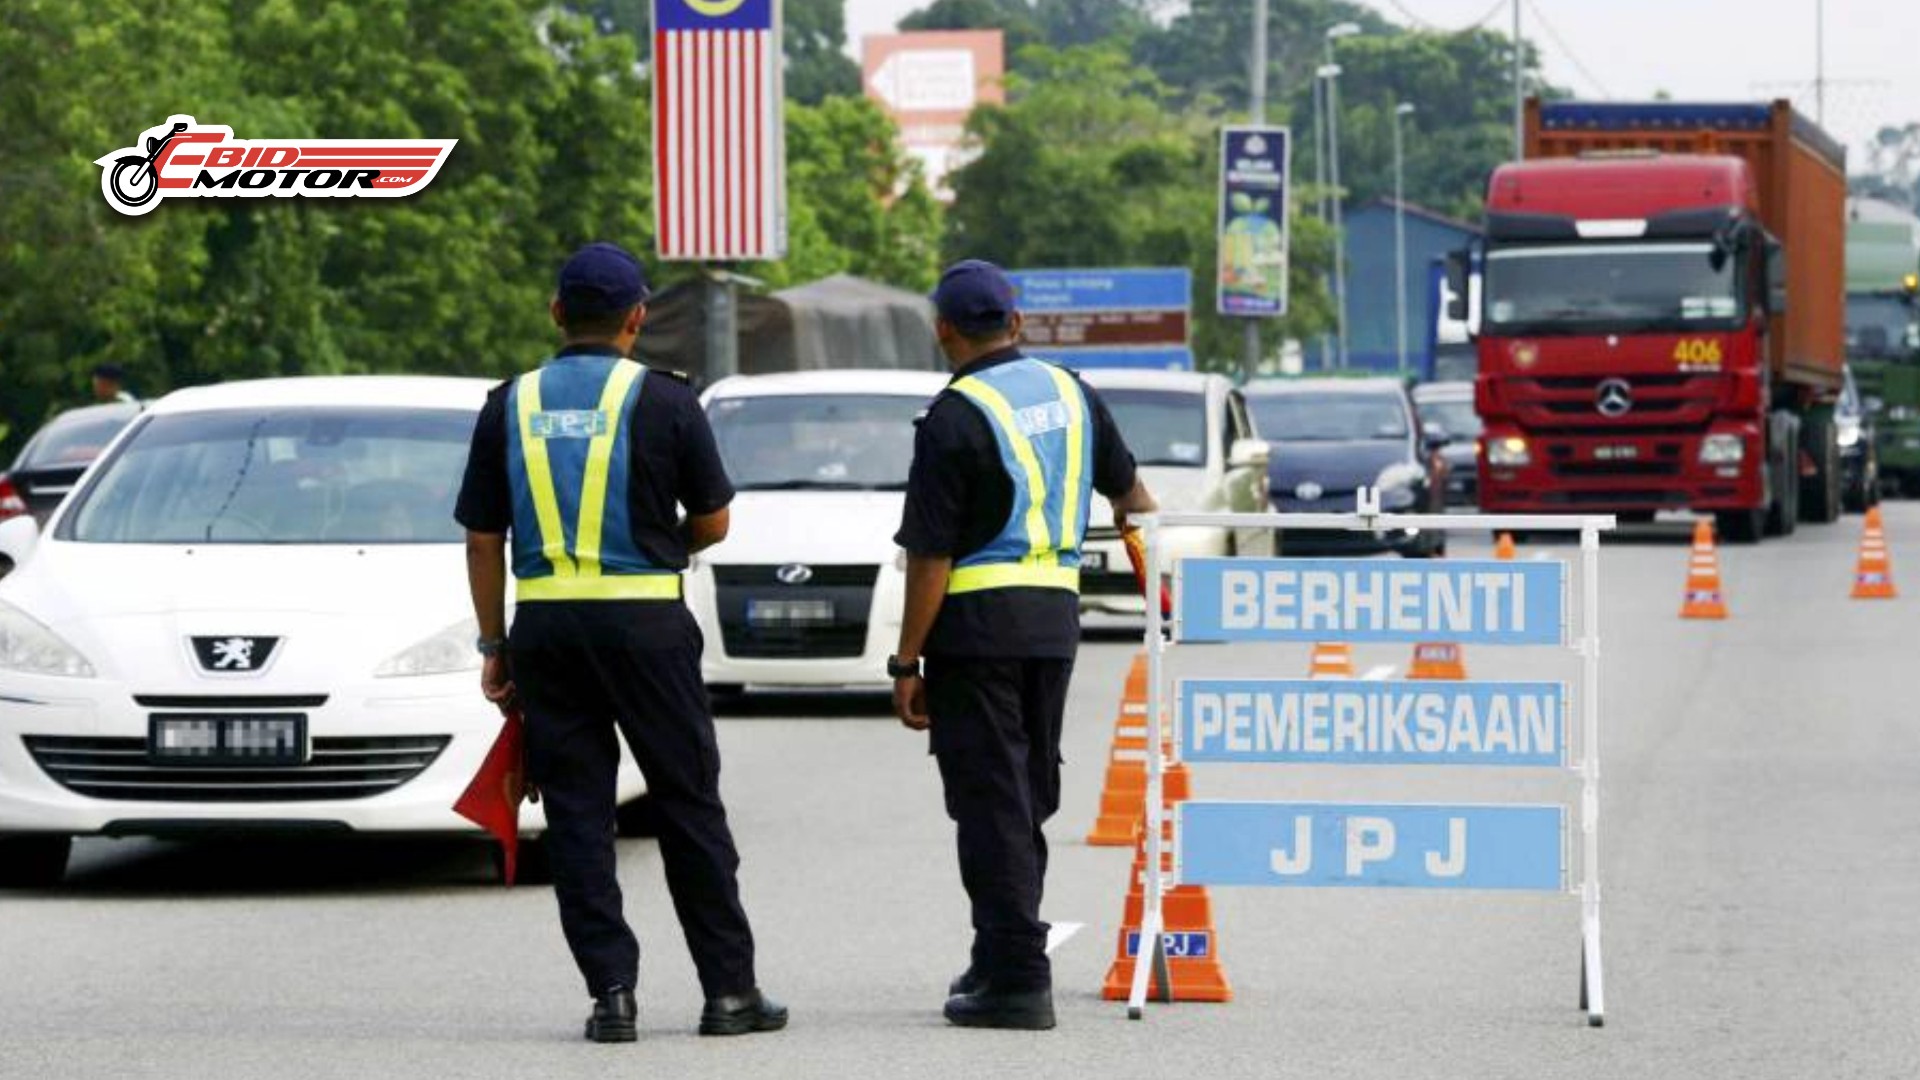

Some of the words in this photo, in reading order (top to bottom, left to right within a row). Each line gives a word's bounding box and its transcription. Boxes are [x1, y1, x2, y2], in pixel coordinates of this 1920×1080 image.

[1673, 339, 1721, 363] 406
[1221, 570, 1525, 632] BERHENTI
[1192, 693, 1555, 754] PEMERIKSAAN
